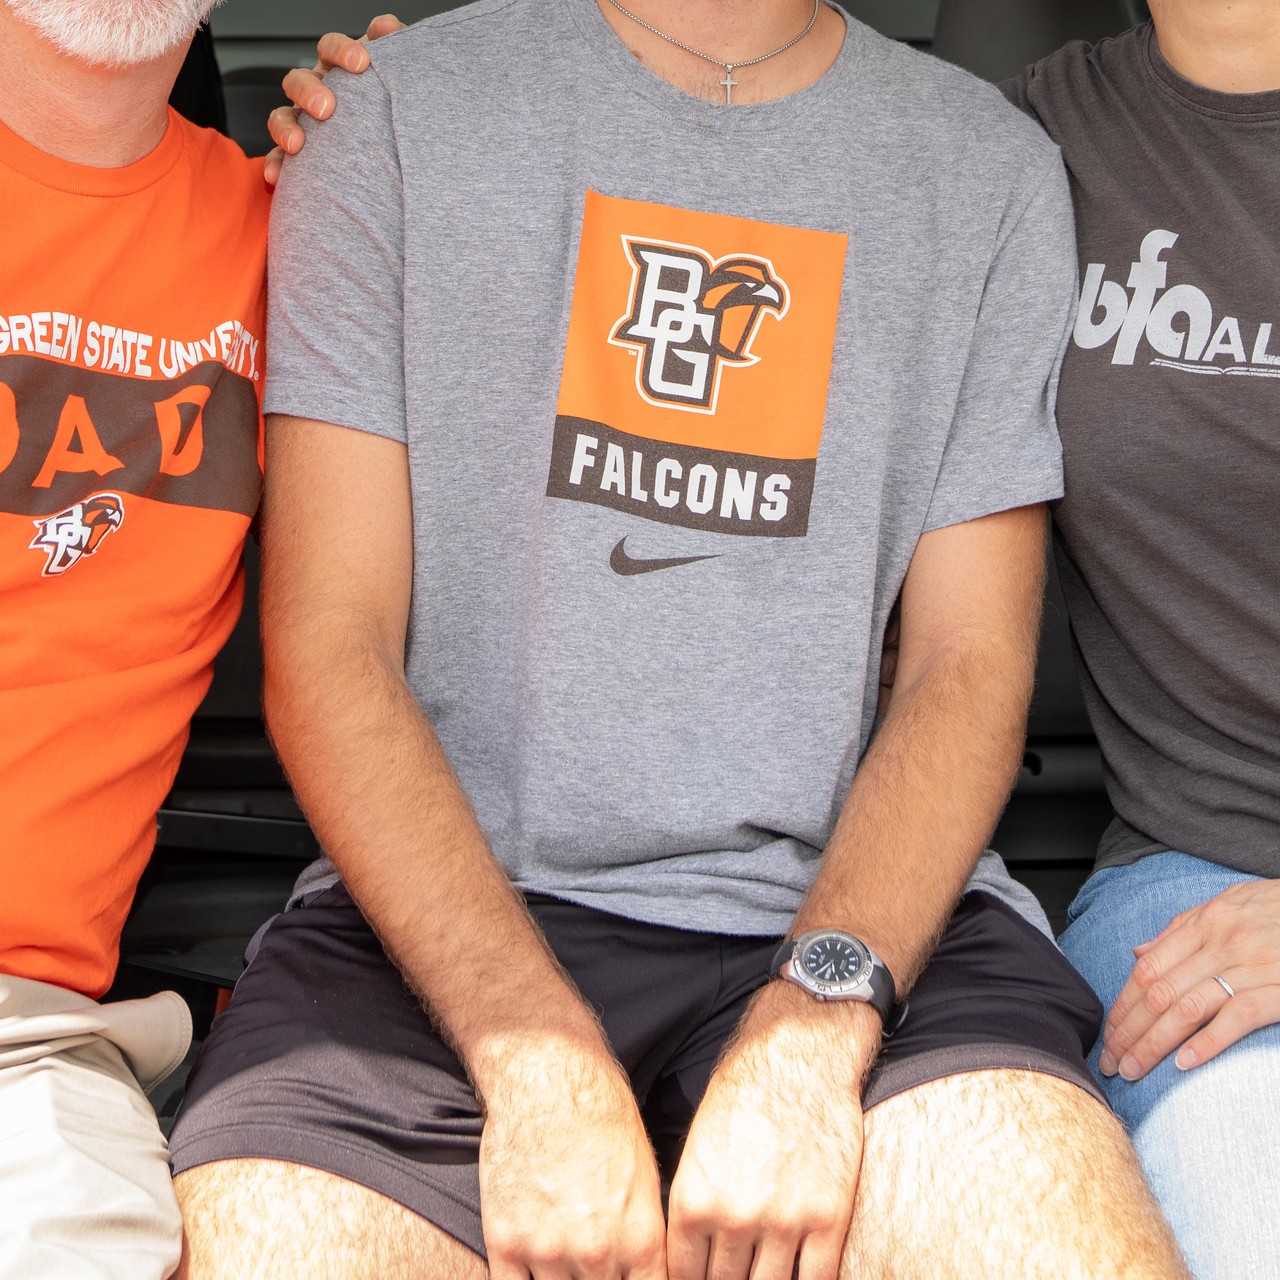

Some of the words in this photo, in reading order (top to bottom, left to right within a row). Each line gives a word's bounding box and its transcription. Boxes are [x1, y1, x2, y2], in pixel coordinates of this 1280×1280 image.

[1073, 228, 1213, 366] bfa
[83, 320, 153, 376] STATE
[568, 433, 792, 521] FALCONS
